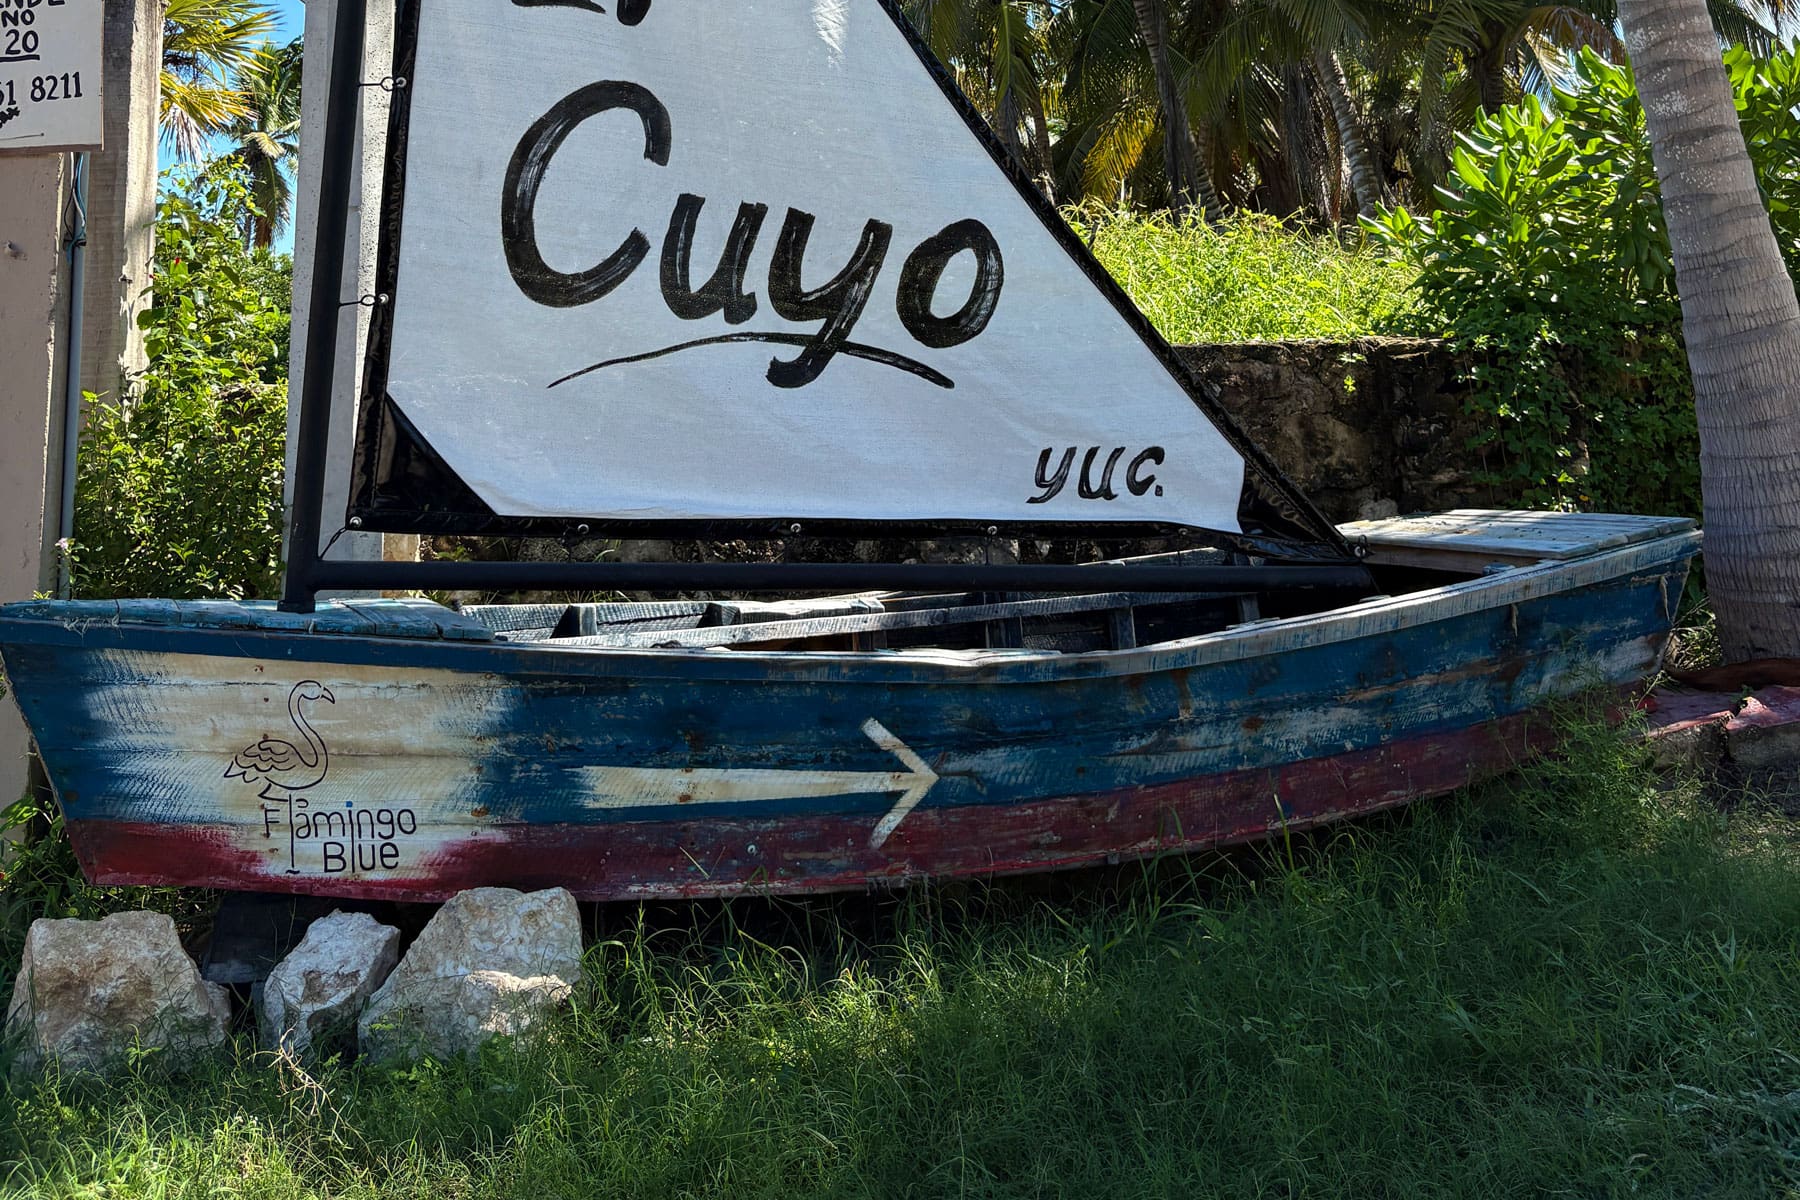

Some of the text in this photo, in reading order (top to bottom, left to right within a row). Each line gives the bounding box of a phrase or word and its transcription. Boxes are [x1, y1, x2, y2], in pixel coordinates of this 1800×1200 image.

[1, 9, 35, 27] NO
[5, 29, 39, 55] 20
[30, 71, 83, 102] 8211
[501, 79, 1004, 388] Cuyo
[264, 795, 416, 868] Flamingo
[323, 842, 400, 873] Blue
